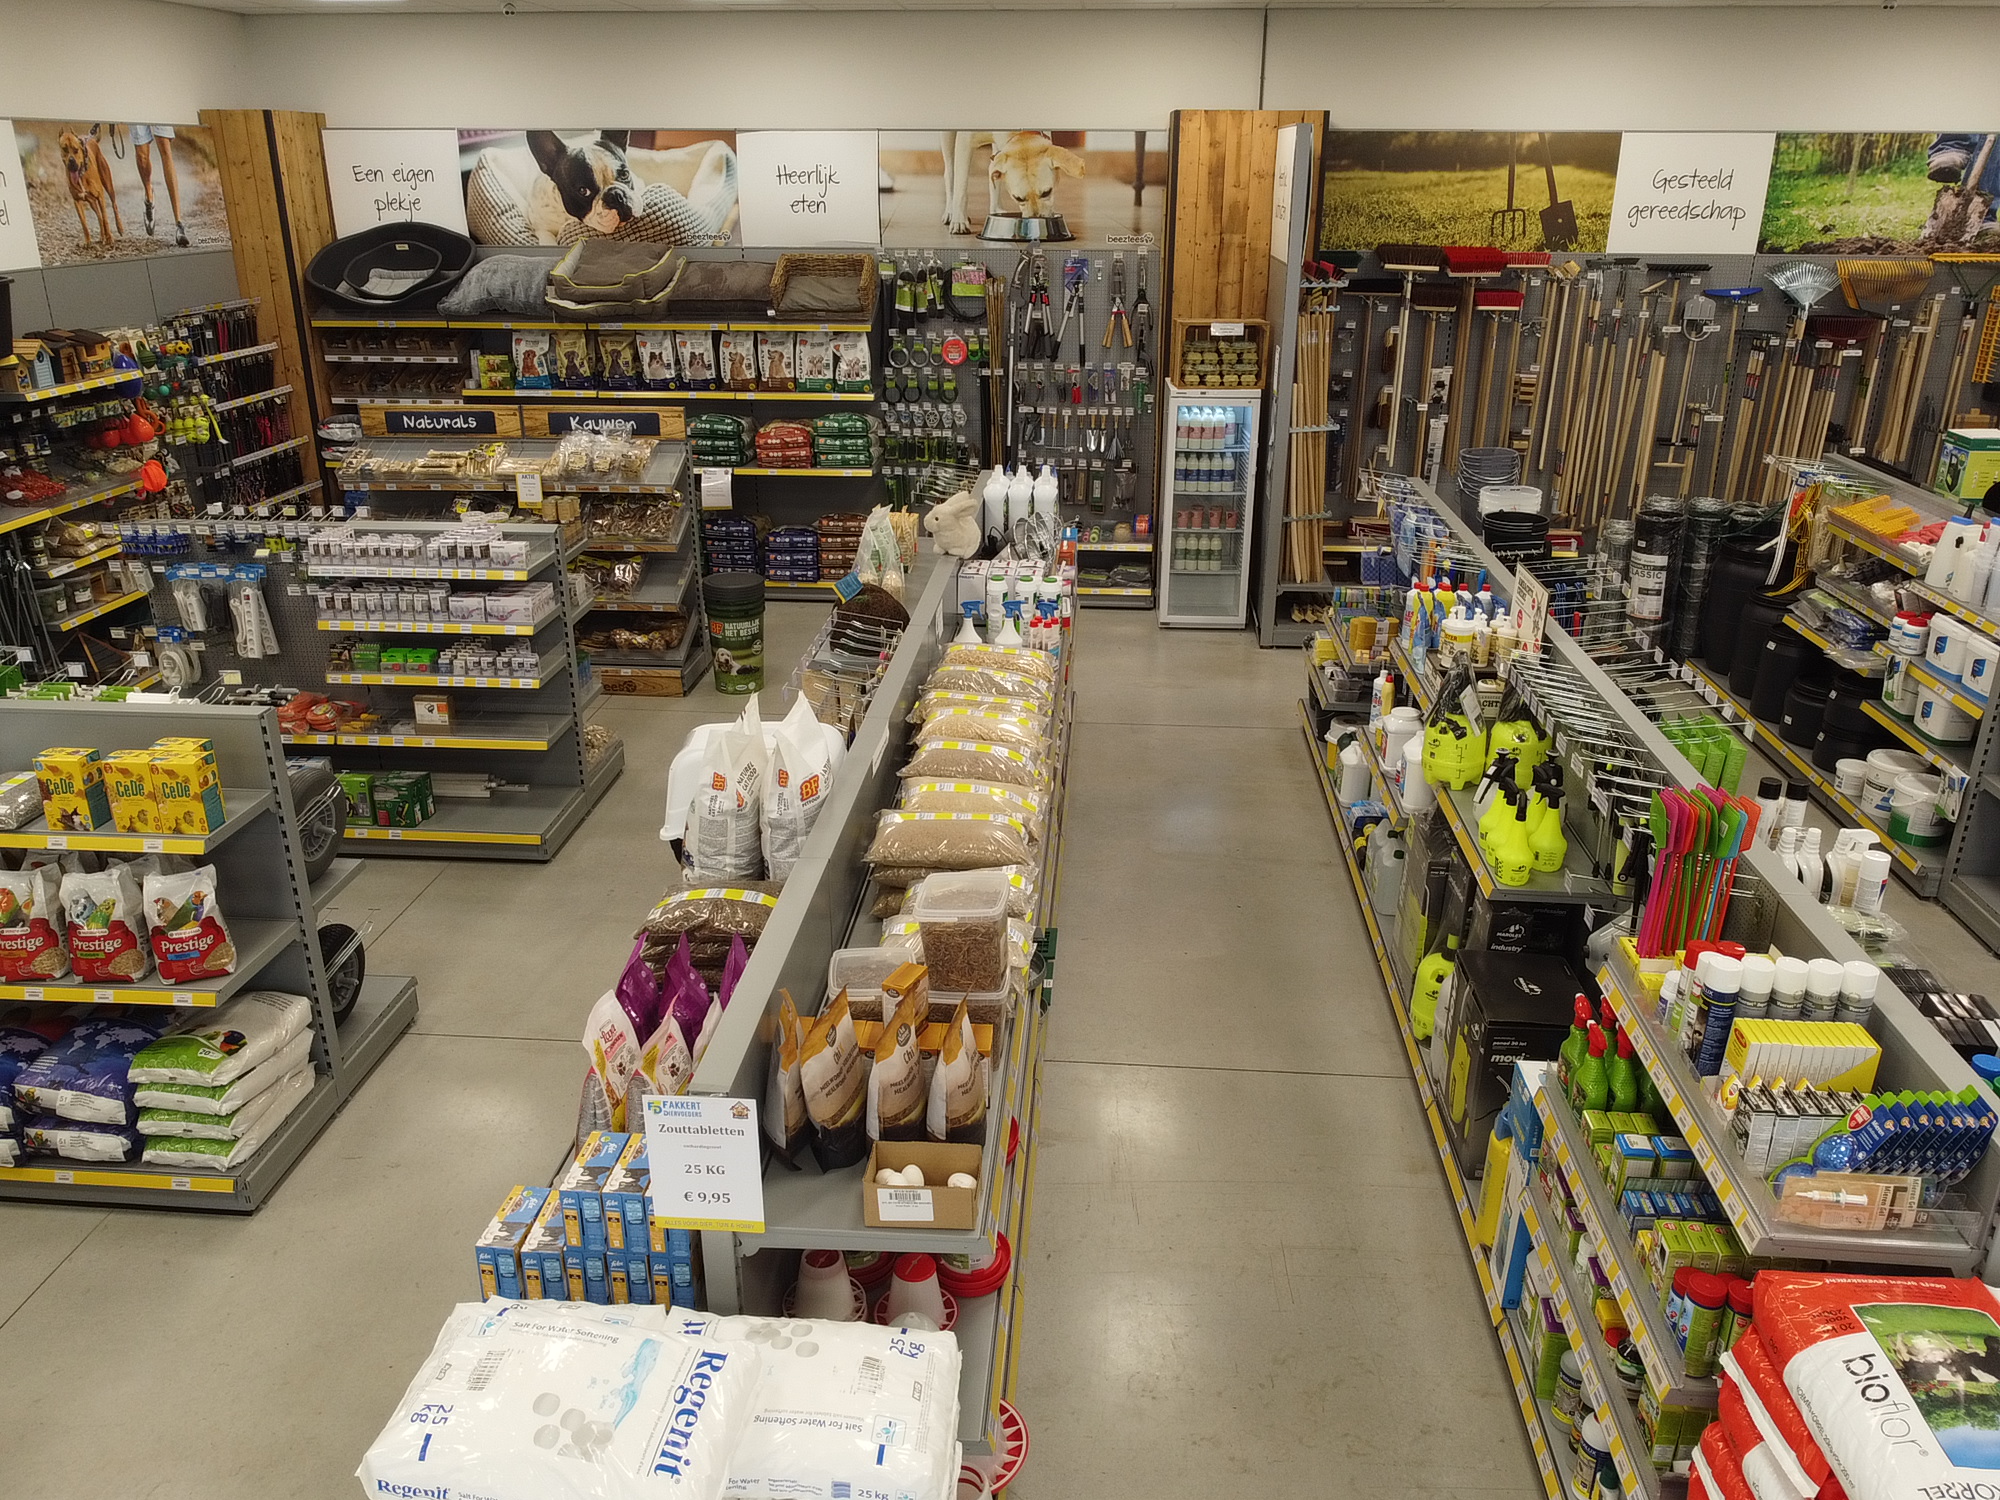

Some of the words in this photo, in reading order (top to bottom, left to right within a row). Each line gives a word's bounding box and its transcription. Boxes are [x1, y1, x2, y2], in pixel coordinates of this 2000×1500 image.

[352, 165, 384, 182] Een
[392, 163, 435, 190] eigen
[776, 164, 840, 198] Heerlijk
[1652, 168, 1735, 194] Gesteeld
[374, 191, 422, 223] plekje
[790, 194, 827, 214] eten
[1628, 199, 1747, 231] gereedschap
[1107, 234, 1145, 245] beeztees
[402, 414, 478, 430] Naturals
[569, 416, 637, 432] Kauwen
[713, 772, 727, 792] BF
[778, 769, 790, 788] BF
[801, 774, 820, 801] BF
[0, 935, 45, 952] restige
[72, 937, 123, 953] Prestige
[160, 933, 215, 953] Prestige
[662, 1101, 702, 1111] FAKKERT
[664, 1110, 702, 1118] DIERVOEDERS
[658, 1124, 745, 1137] Zouttabletten
[684, 1164, 702, 1175] 25
[706, 1165, 726, 1176] KG
[684, 1192, 694, 1203] €
[697, 1192, 731, 1205] 9,95
[1880, 1186, 1892, 1207] Mieren
[1878, 1207, 1887, 1217] Gel
[1920, 1282, 1947, 1290] Geeft
[512, 1320, 532, 1332] Salt
[533, 1322, 547, 1333] For
[548, 1324, 576, 1336] Water
[576, 1328, 620, 1346] Softening
[1839, 1322, 1855, 1330] 20
[889, 1338, 906, 1355] 25
[902, 1341, 926, 1360] kg
[410, 1404, 439, 1424] kg
[432, 1404, 454, 1426] 25
[753, 1414, 798, 1426] Softening
[798, 1418, 827, 1430] Water
[828, 1421, 843, 1431] For
[844, 1423, 863, 1434] Salt
[376, 1479, 451, 1500] Regenit
[728, 1478, 739, 1486] For
[740, 1478, 761, 1487] Water
[858, 1490, 873, 1499] 25
[874, 1491, 889, 1500] kg
